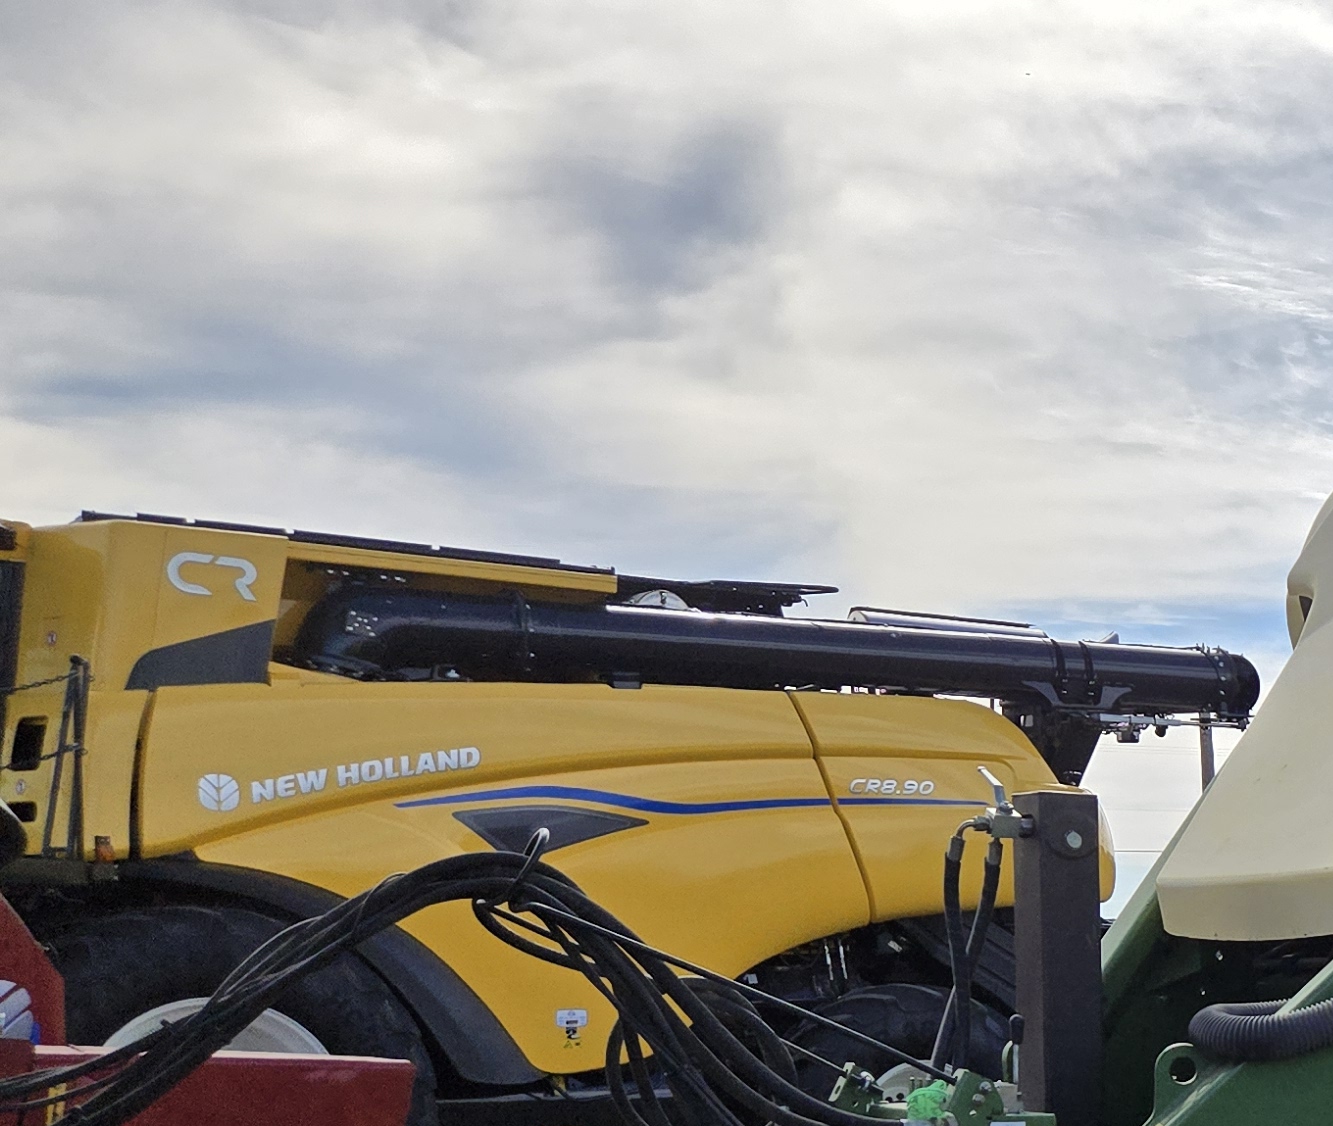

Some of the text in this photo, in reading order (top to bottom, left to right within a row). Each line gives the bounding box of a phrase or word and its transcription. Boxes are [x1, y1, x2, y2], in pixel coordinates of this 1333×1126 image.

[167, 552, 257, 602] CR
[252, 746, 481, 803] NEW HOLLAND
[850, 778, 934, 795] CR8.90
